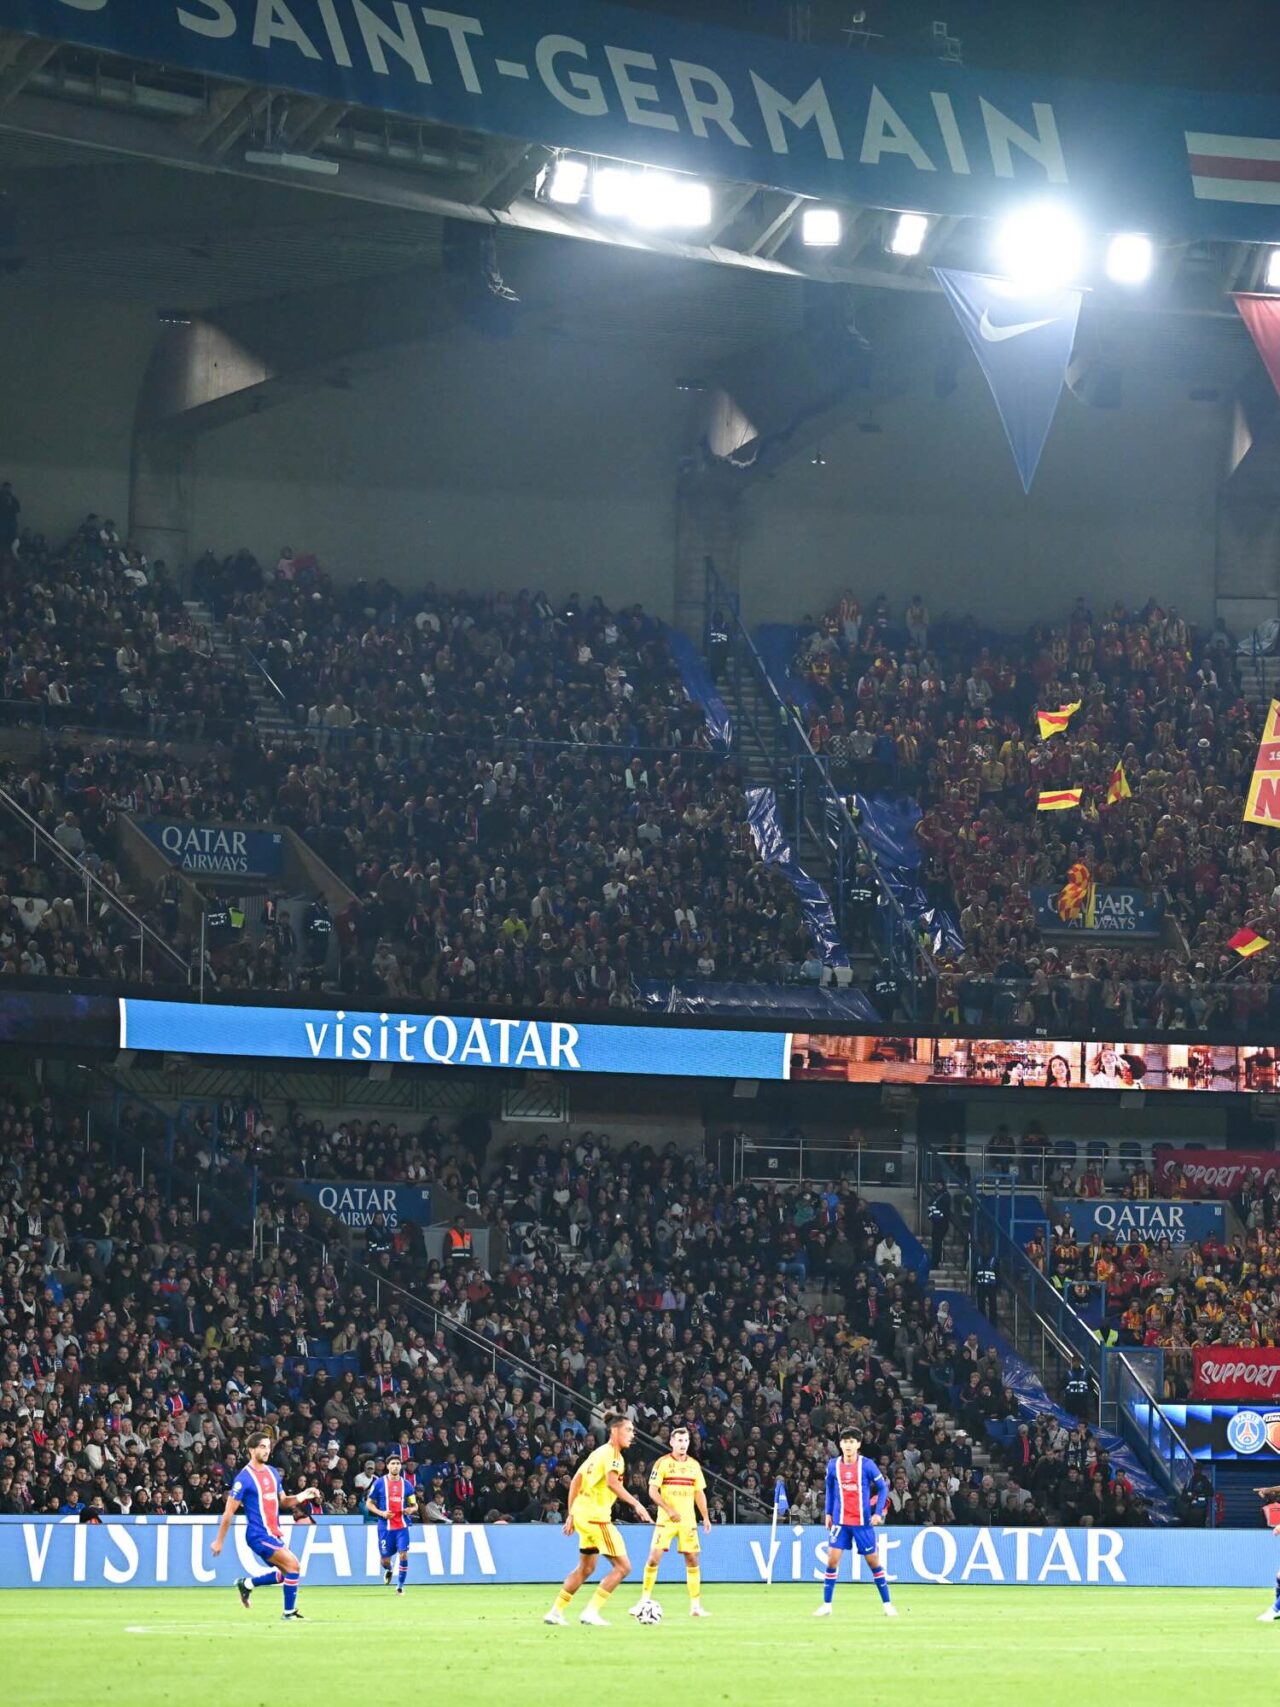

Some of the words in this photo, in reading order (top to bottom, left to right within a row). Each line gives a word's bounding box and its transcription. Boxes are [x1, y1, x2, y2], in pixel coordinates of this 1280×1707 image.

[162, 826, 247, 855] QATAR
[182, 853, 248, 872] AIRWAYS
[1068, 914, 1136, 930] AIWAYS
[318, 1187, 397, 1214] QATAR
[339, 1211, 398, 1227] AIRWYS
[1094, 1205, 1185, 1231] QATAR
[1116, 1228, 1186, 1242] AIWAYS
[381, 1539, 387, 1549] 2
